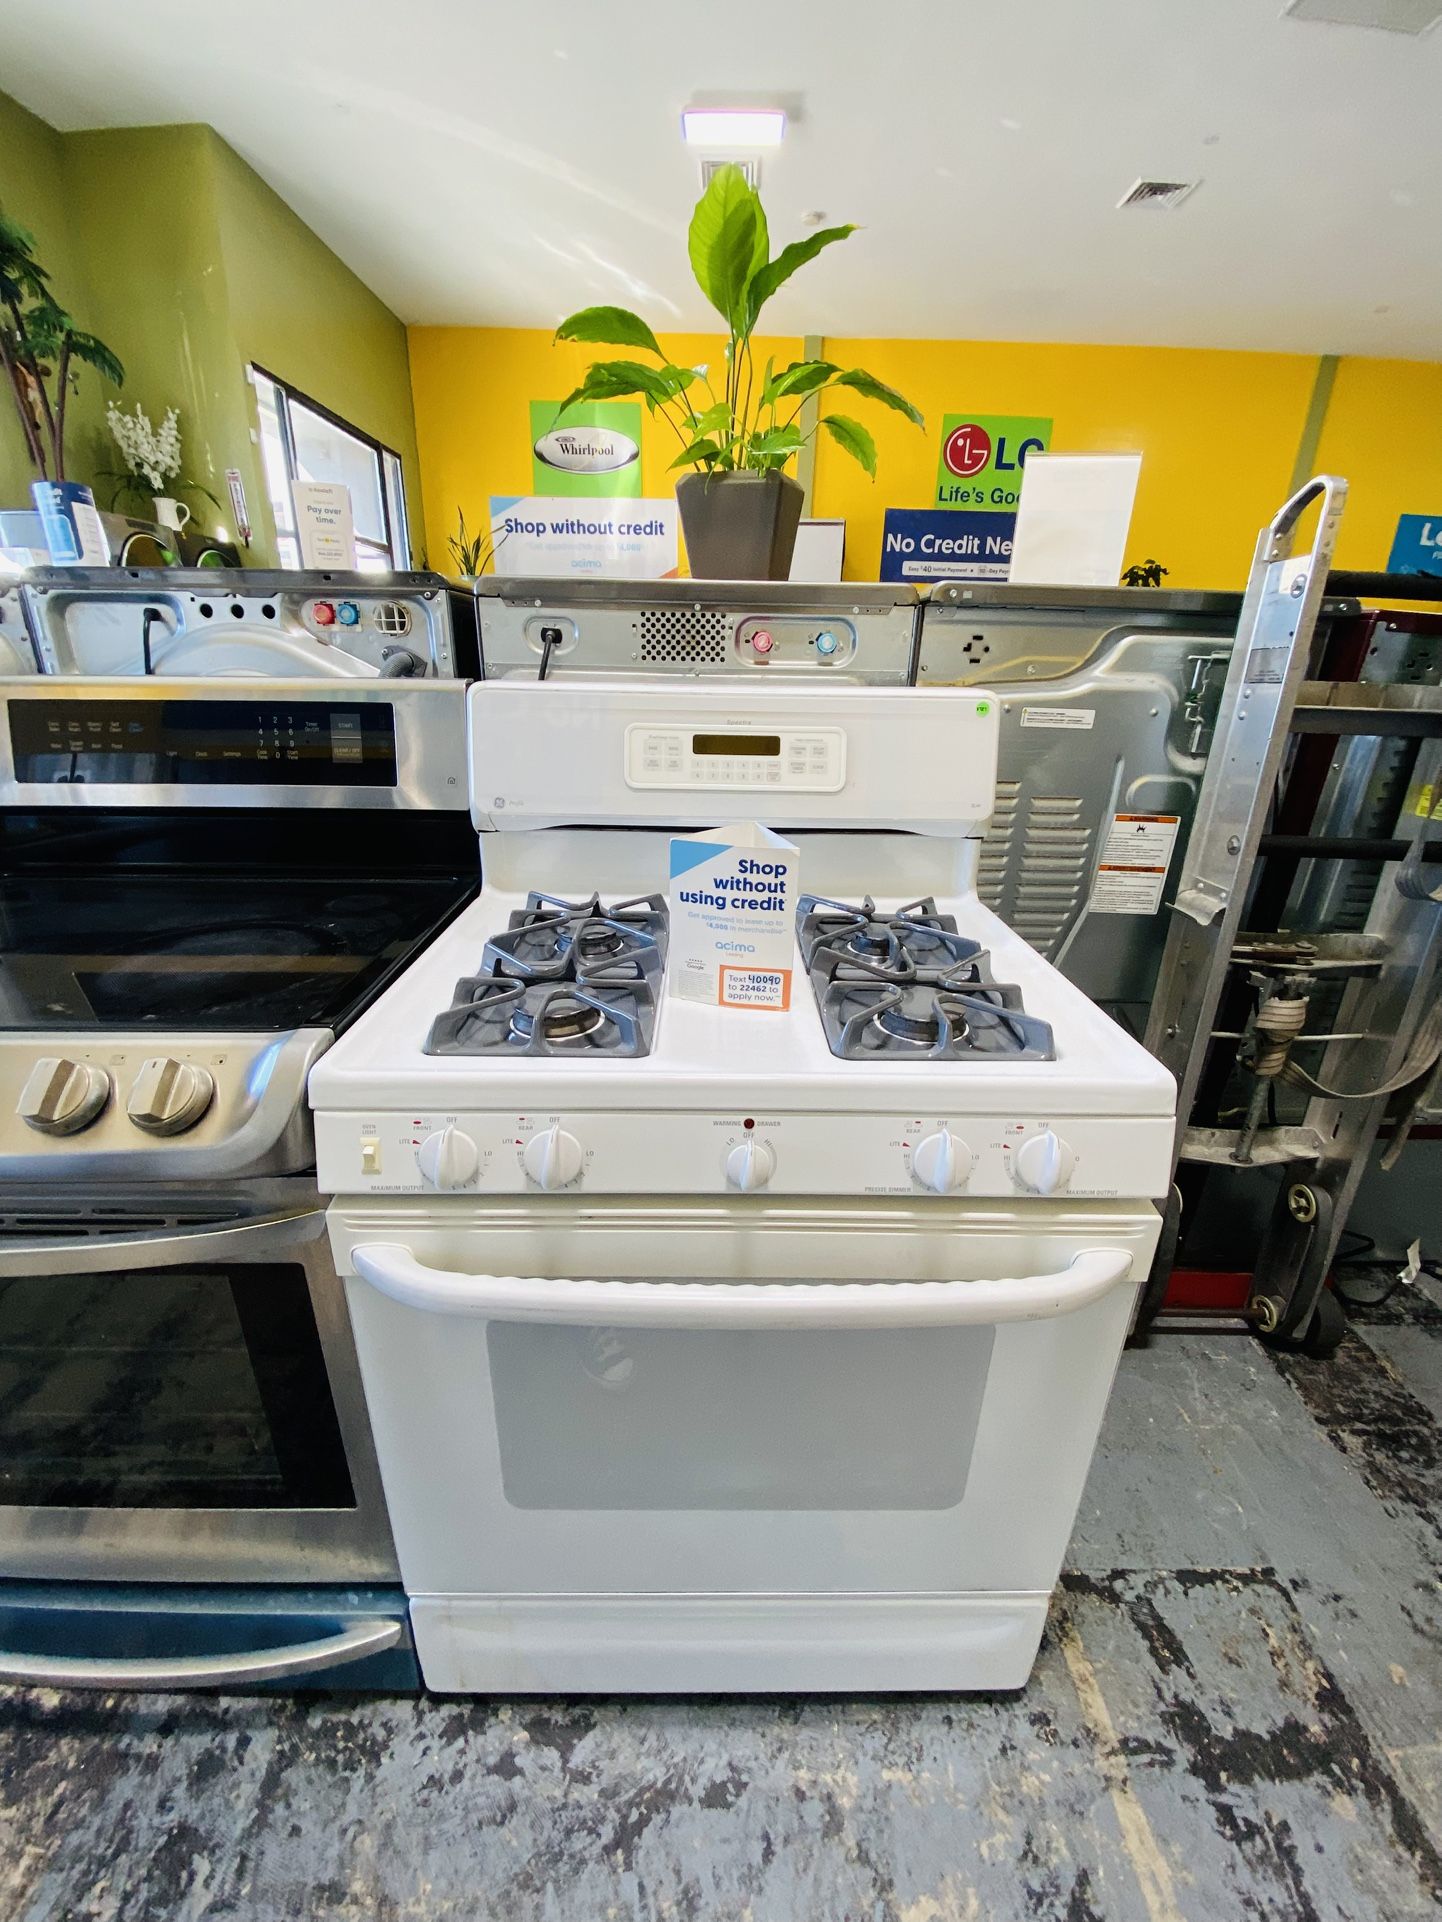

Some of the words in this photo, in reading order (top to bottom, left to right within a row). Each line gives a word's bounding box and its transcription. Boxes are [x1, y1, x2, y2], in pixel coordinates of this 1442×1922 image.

[559, 442, 614, 458] Whirlpool
[938, 486, 984, 504] Life's
[504, 518, 547, 537] Shop
[550, 518, 614, 536] without
[618, 519, 665, 536] credit
[886, 532, 915, 553] No
[920, 533, 980, 555] Credit
[737, 858, 787, 879] Shop
[712, 876, 787, 894] without
[679, 890, 726, 911] using
[715, 941, 756, 953] acima
[728, 974, 747, 983] Text
[728, 983, 738, 991] to
[739, 984, 767, 993] 22462
[768, 986, 779, 994] to
[727, 991, 753, 1003] apply
[446, 1116, 458, 1124] OFF
[549, 1116, 561, 1124] OFF
[370, 1184, 402, 1192] MAXIMUM
[402, 1184, 425, 1192] OUTPUT
